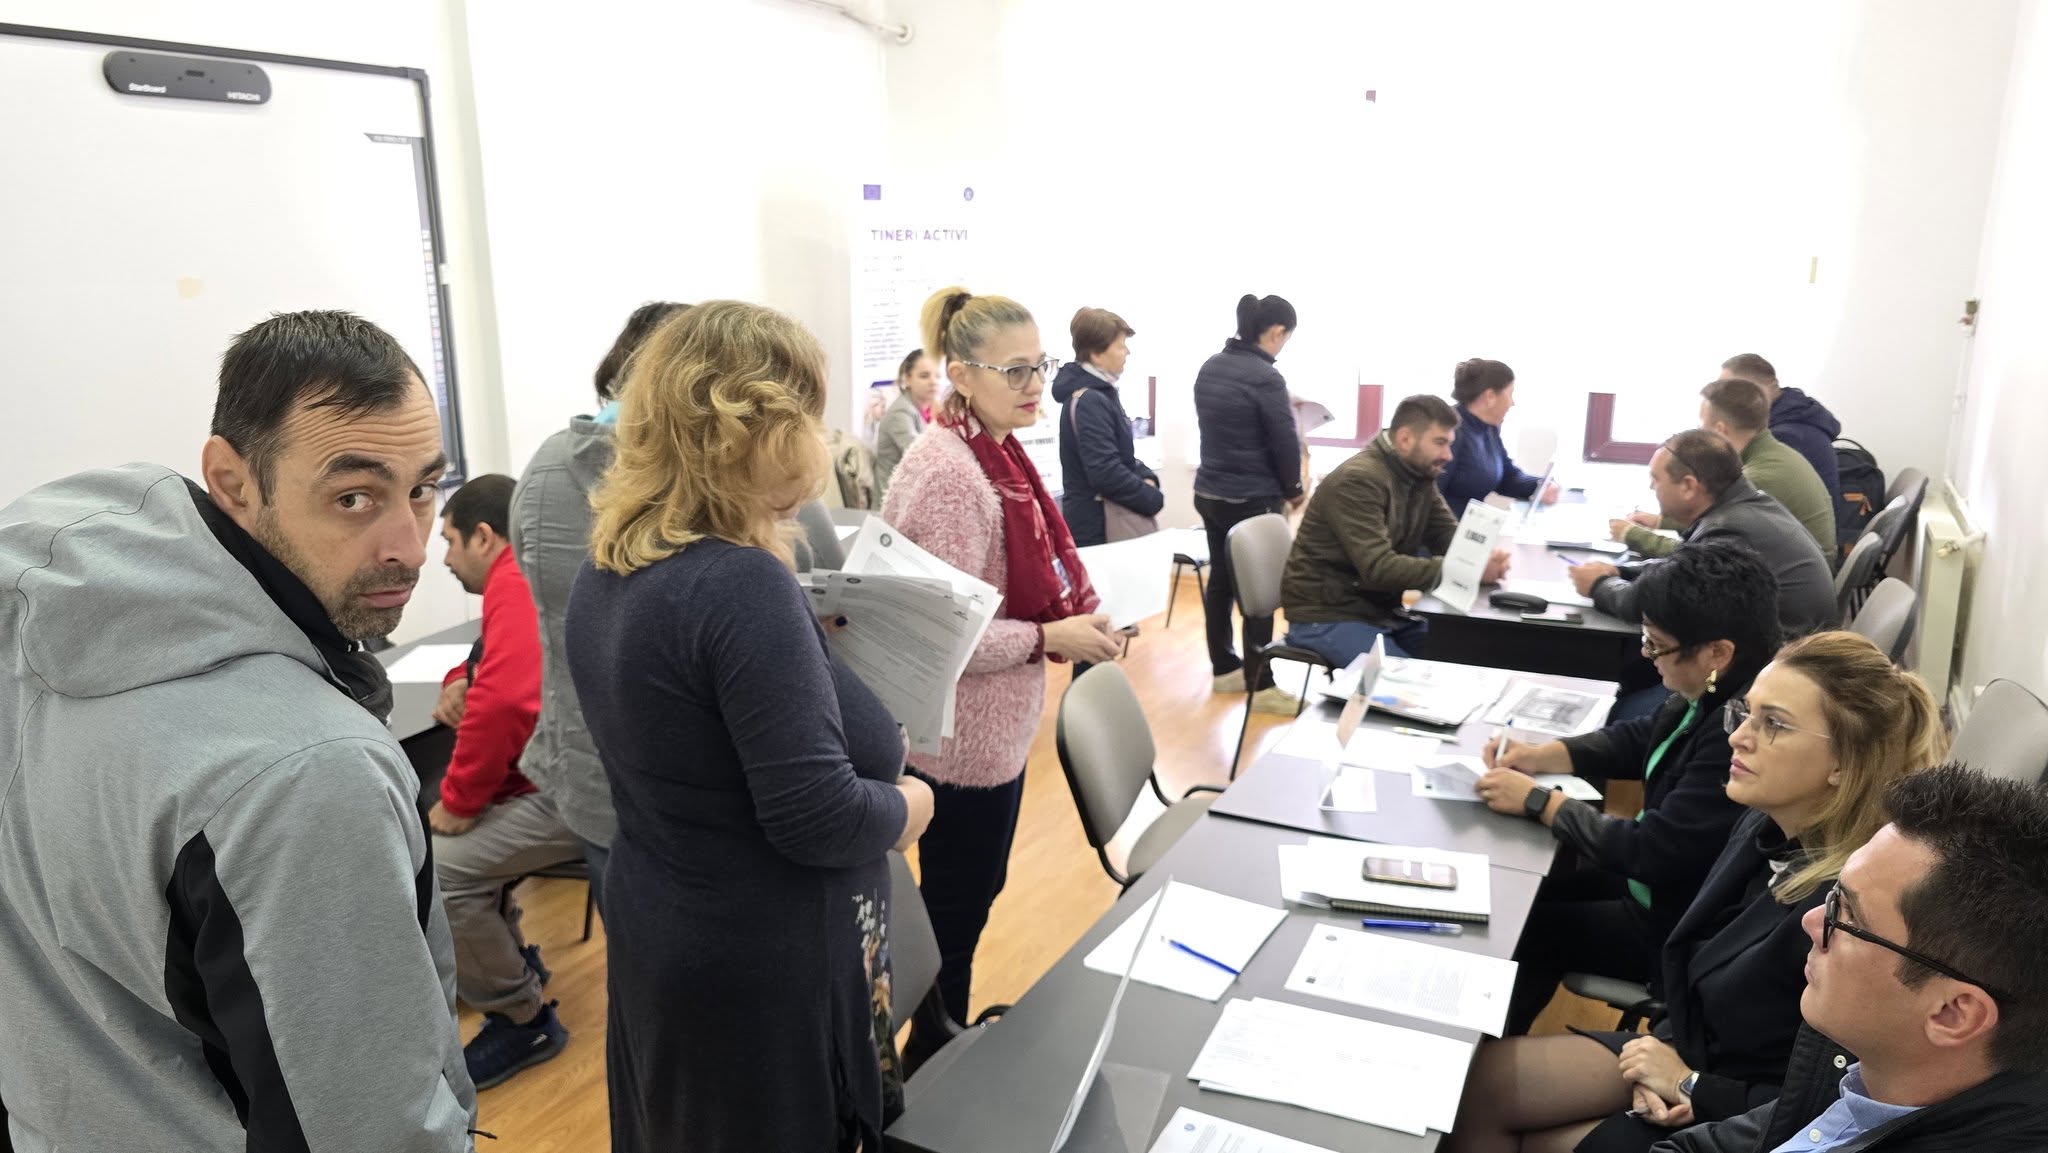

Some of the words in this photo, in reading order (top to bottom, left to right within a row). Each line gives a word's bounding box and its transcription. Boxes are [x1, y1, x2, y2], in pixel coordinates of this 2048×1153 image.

[226, 91, 261, 101] HITACHI
[871, 229, 918, 241] TINERI
[923, 229, 968, 241] ACTIVI
